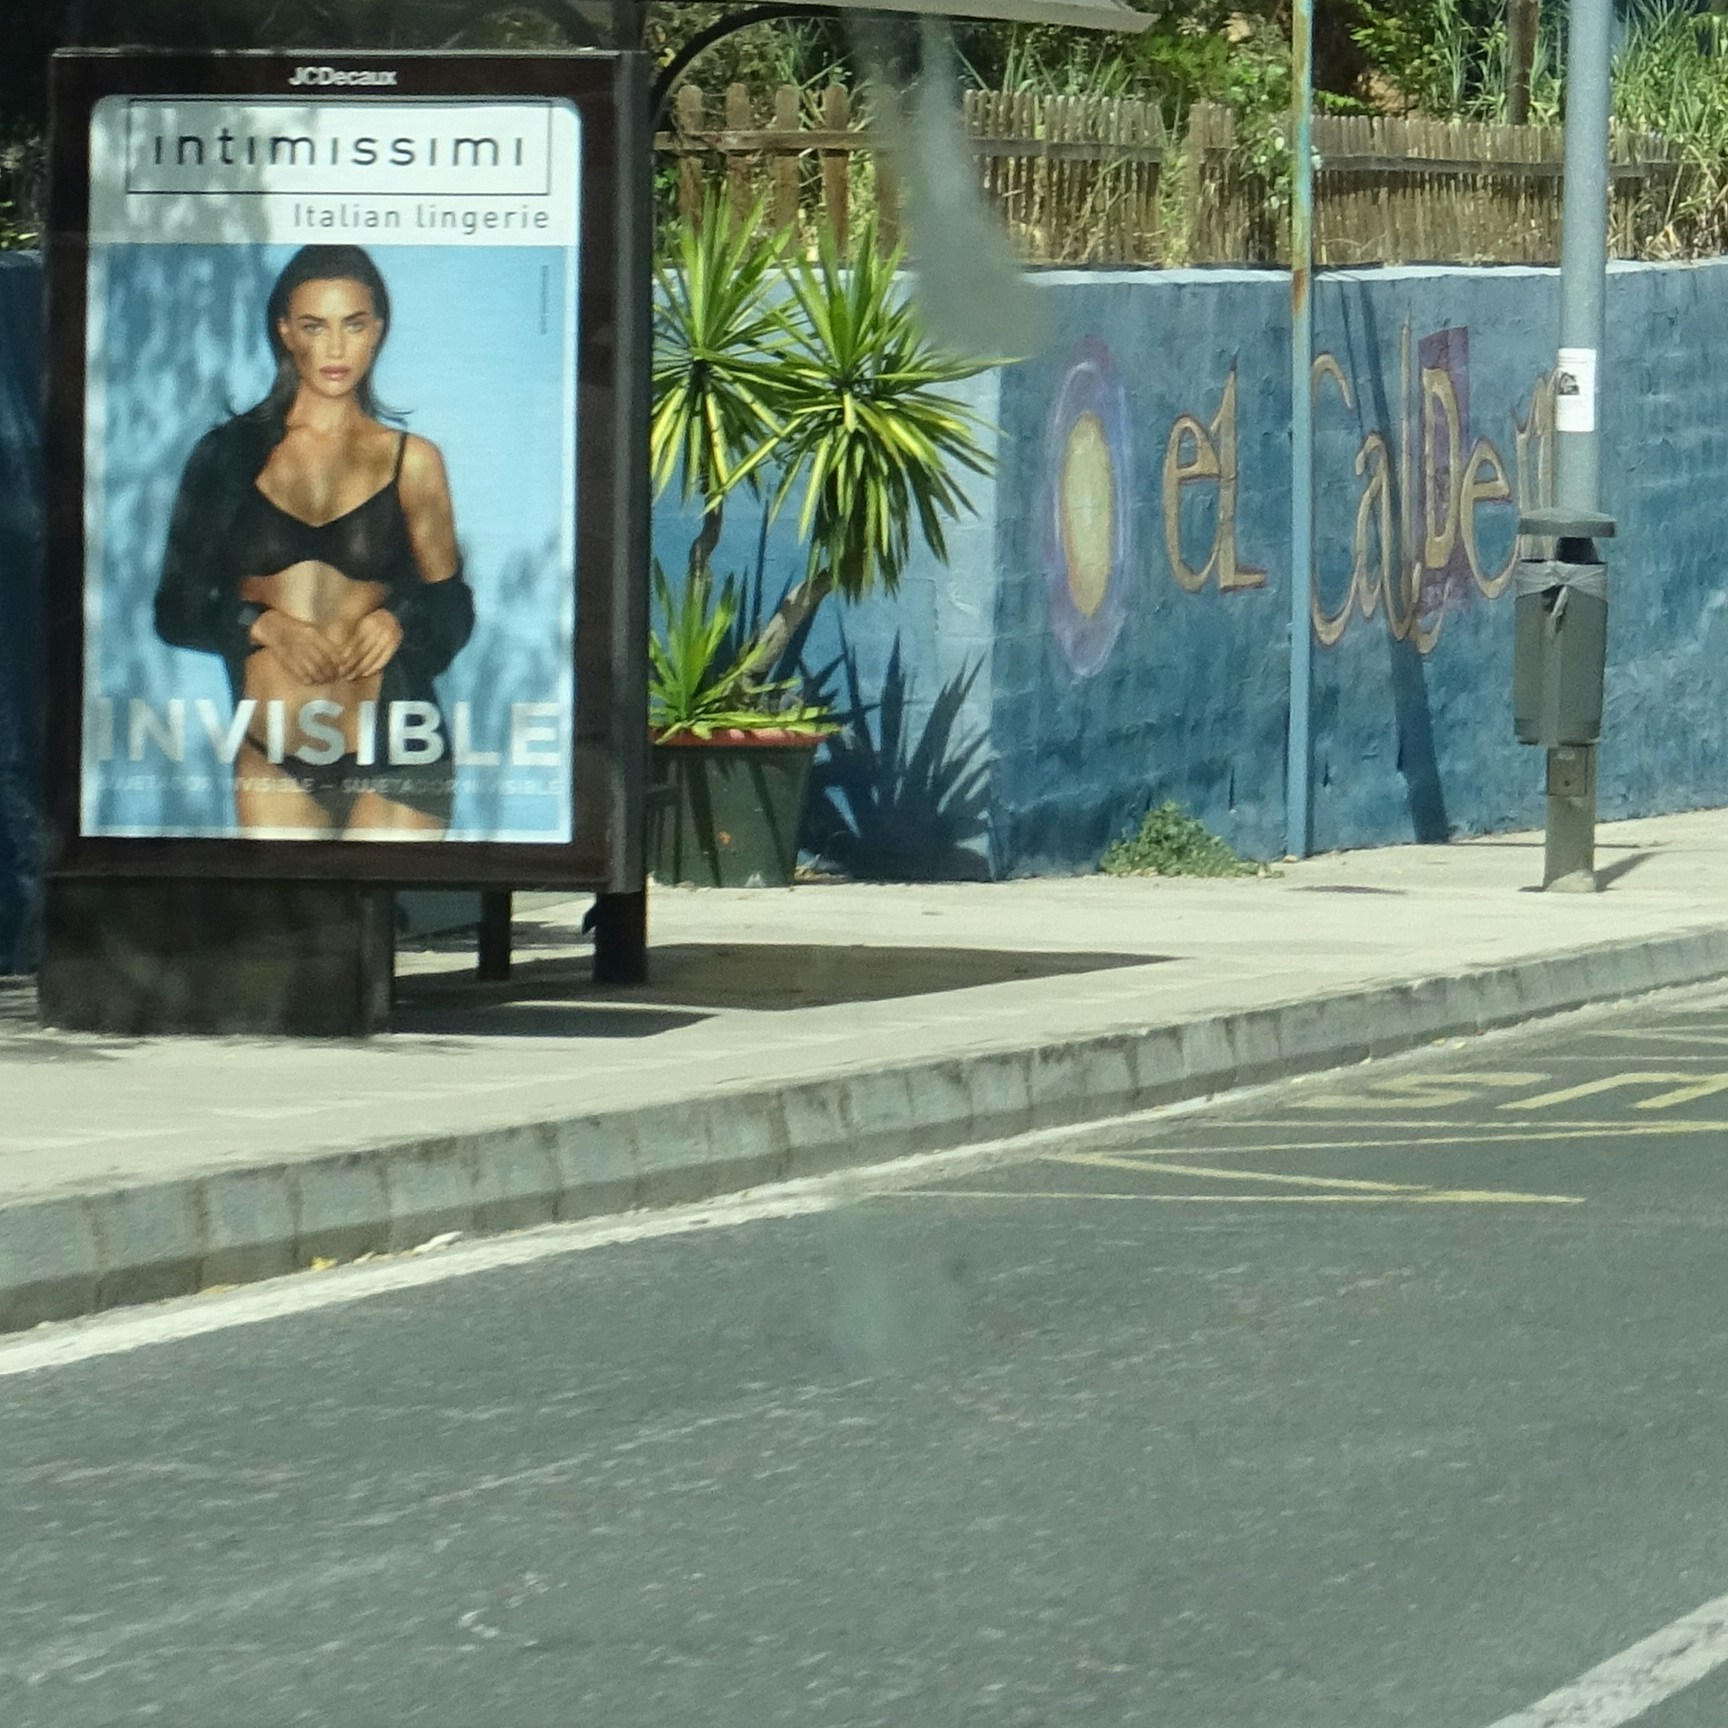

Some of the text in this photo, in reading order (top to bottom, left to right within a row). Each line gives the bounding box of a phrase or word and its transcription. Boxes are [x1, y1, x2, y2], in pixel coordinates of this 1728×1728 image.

[288, 66, 397, 85] JCDecaux
[154, 129, 523, 166] intimissimi
[295, 203, 549, 235] Italian lingerie
[97, 700, 564, 766] INVISIBLE
